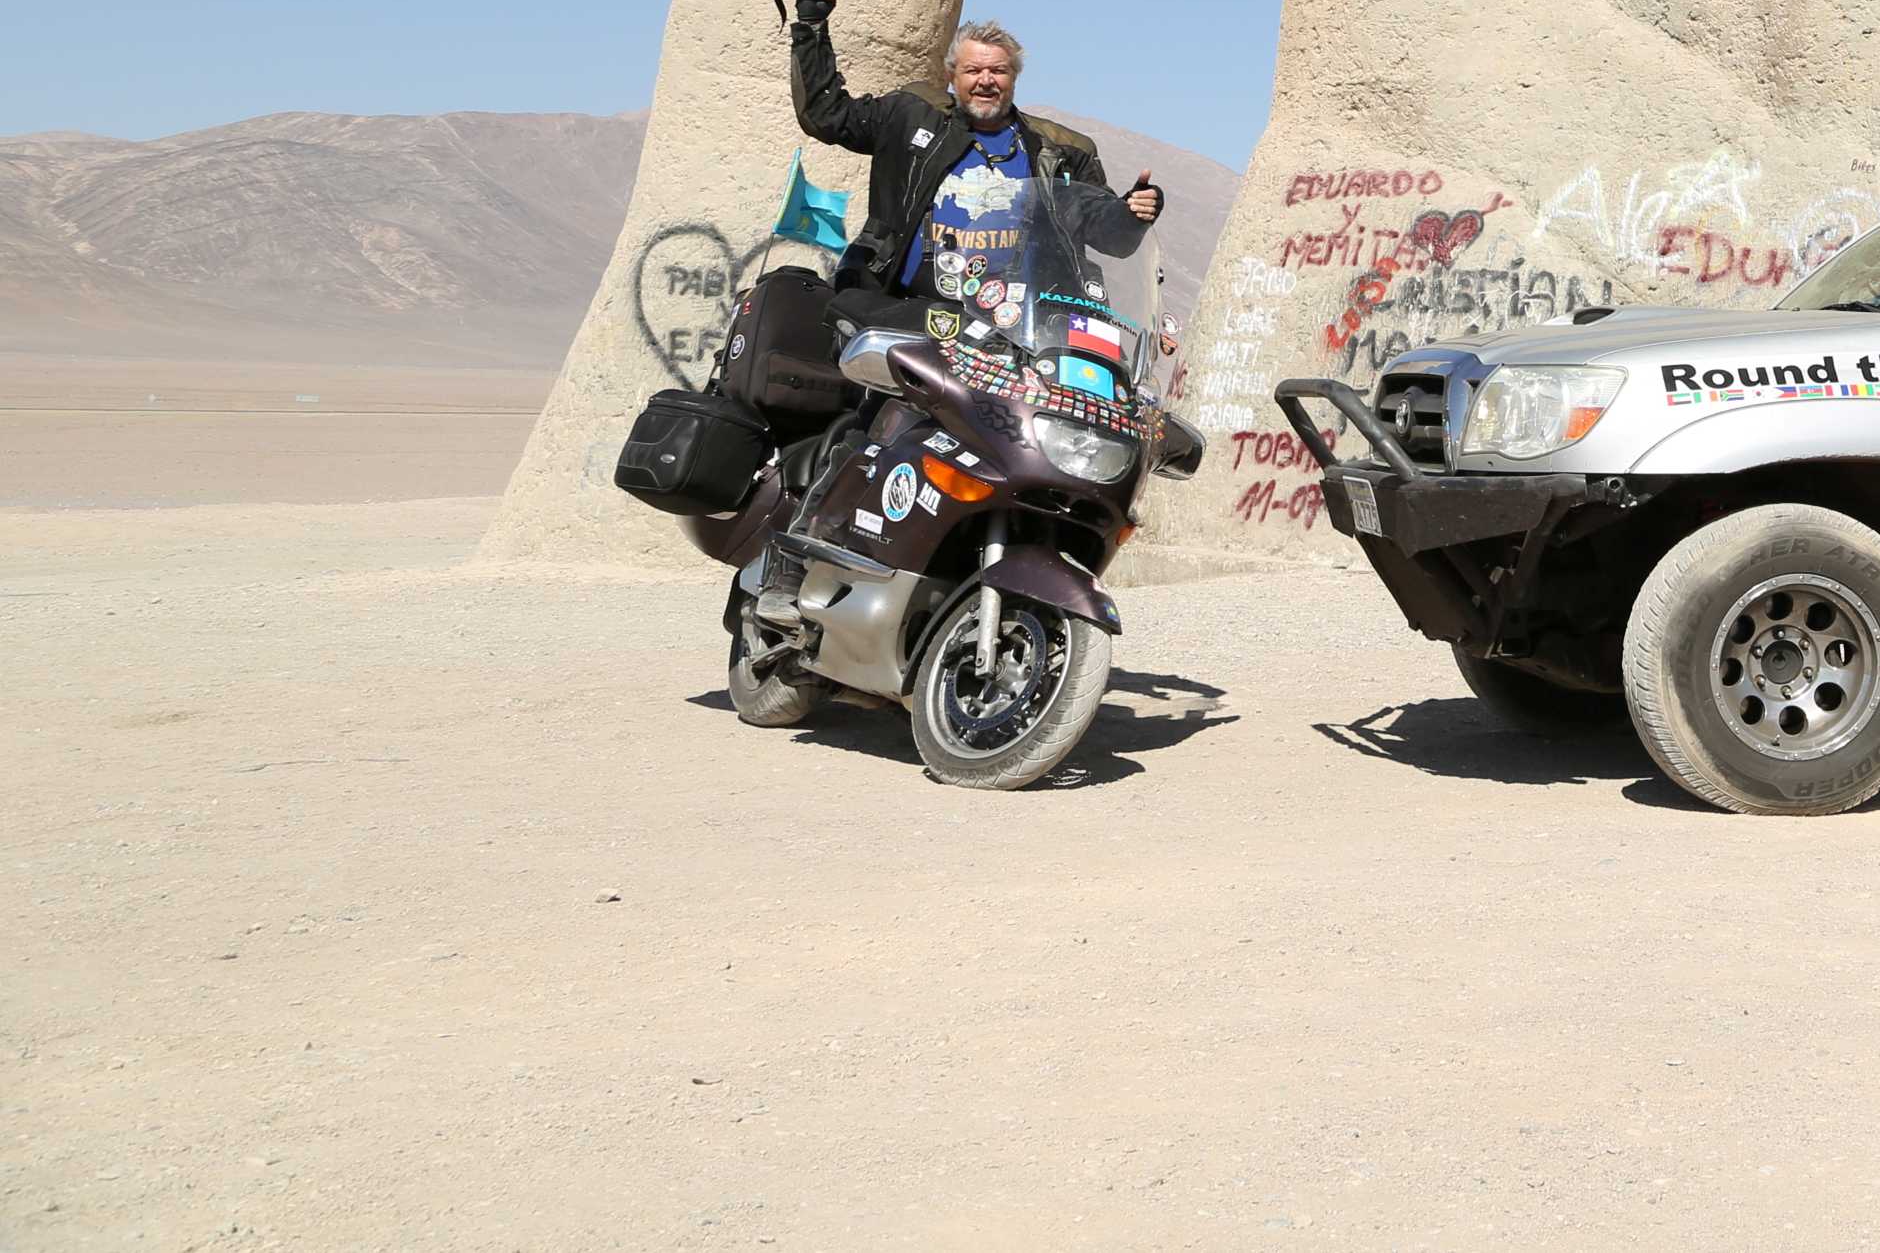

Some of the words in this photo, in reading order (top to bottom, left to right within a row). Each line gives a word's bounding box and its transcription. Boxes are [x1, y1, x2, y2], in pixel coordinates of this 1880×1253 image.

[1284, 169, 1445, 208] EDUARDO
[932, 222, 1020, 250] ZAKHSTAN
[1661, 356, 1838, 393] Round
